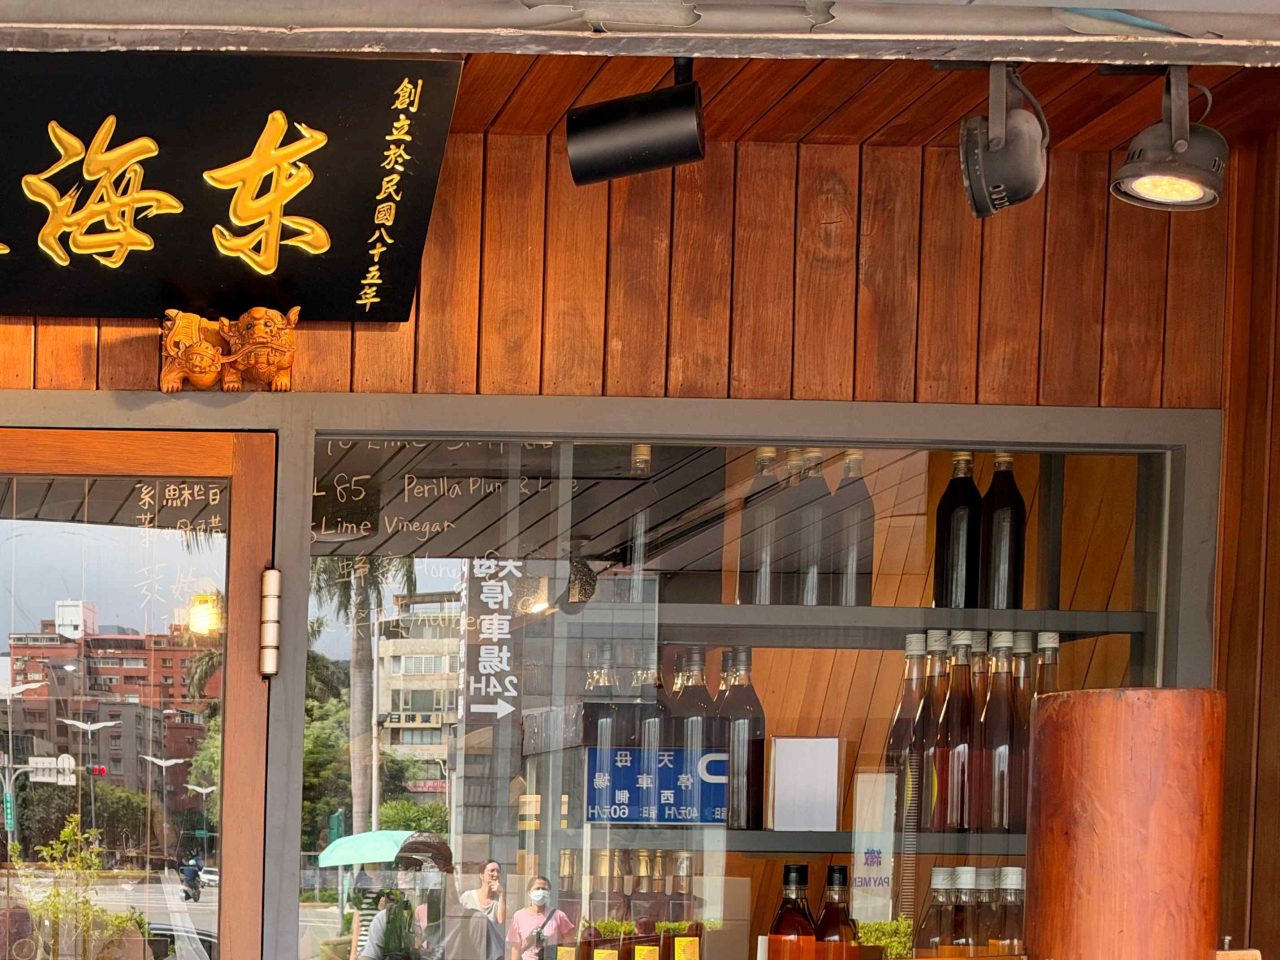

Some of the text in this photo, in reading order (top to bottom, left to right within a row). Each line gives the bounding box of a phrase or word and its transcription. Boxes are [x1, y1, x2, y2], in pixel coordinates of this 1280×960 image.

[356, 77, 423, 312] 創立於民國八十五年
[333, 472, 371, 503] 85
[404, 474, 463, 502] Perilla
[537, 475, 580, 493] Le
[321, 516, 457, 541] Lime Vinegar
